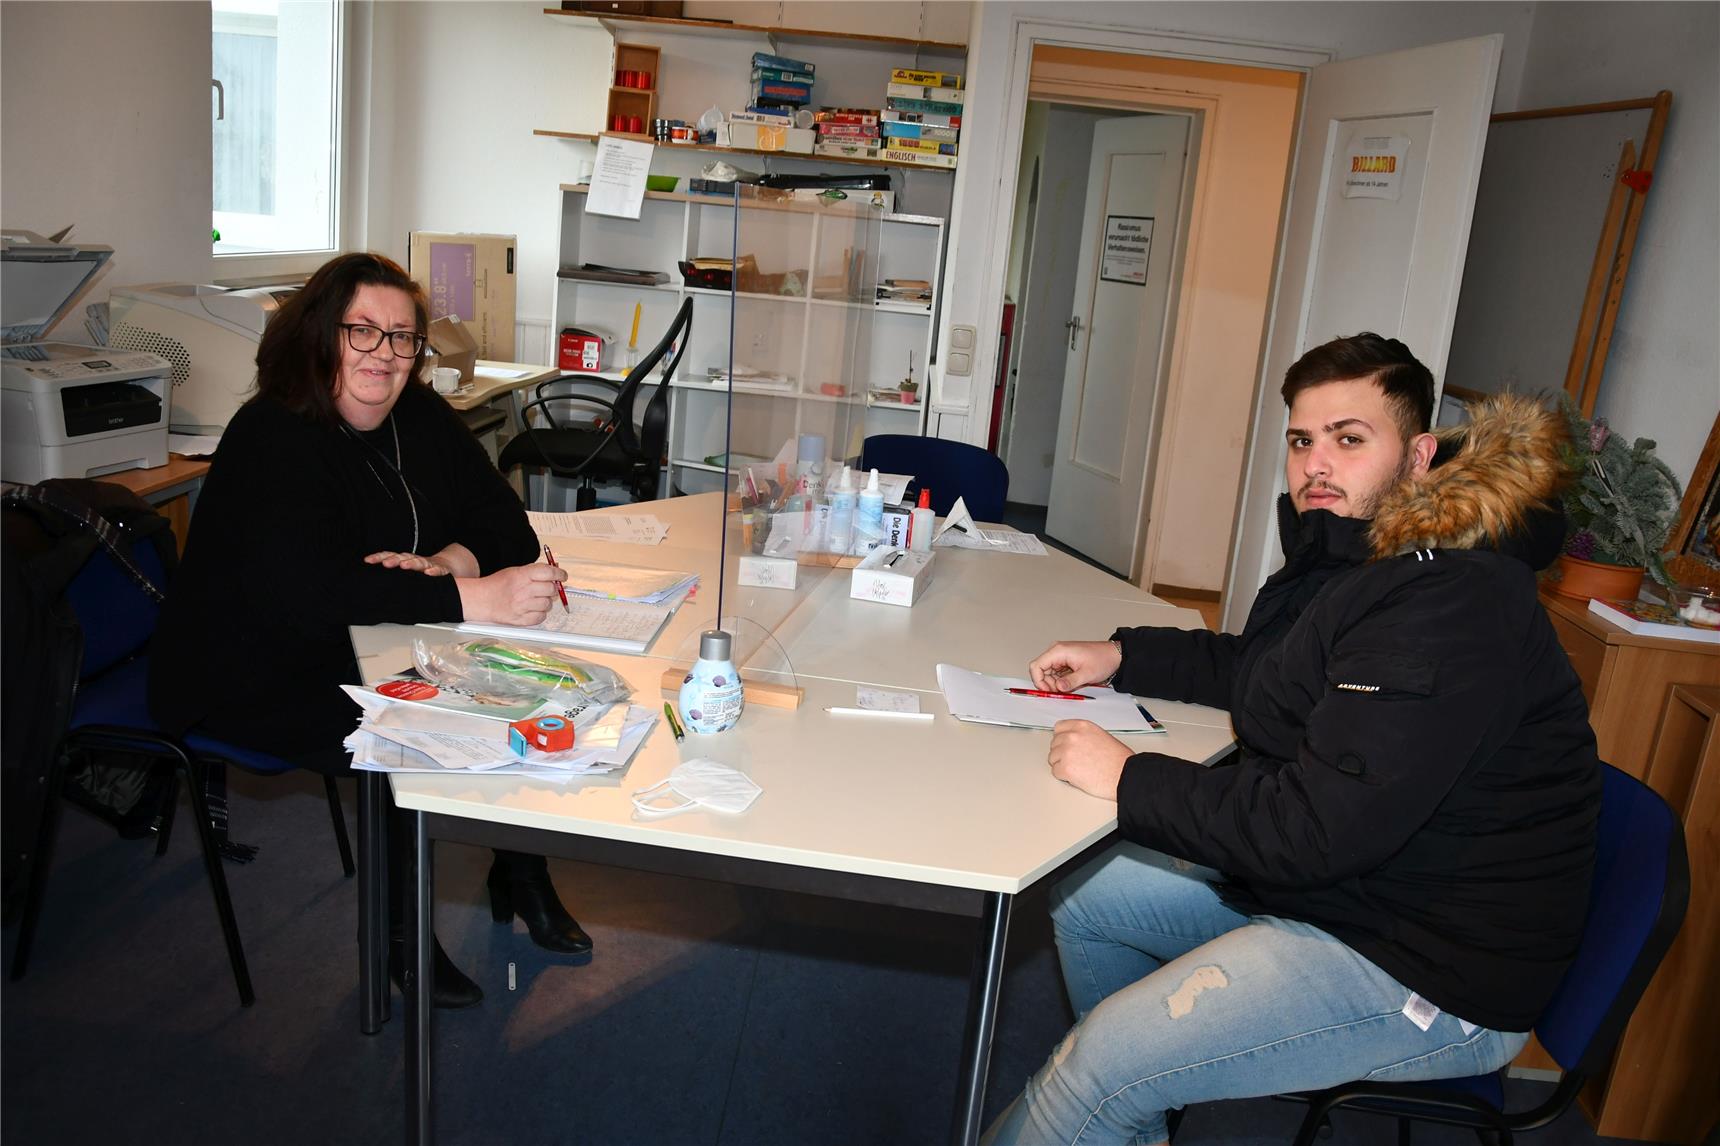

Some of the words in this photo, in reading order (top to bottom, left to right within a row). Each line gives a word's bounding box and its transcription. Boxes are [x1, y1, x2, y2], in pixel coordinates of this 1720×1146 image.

[885, 150, 917, 161] ENGLISCH
[1352, 155, 1396, 173] BILLARD
[892, 517, 902, 529] Die
